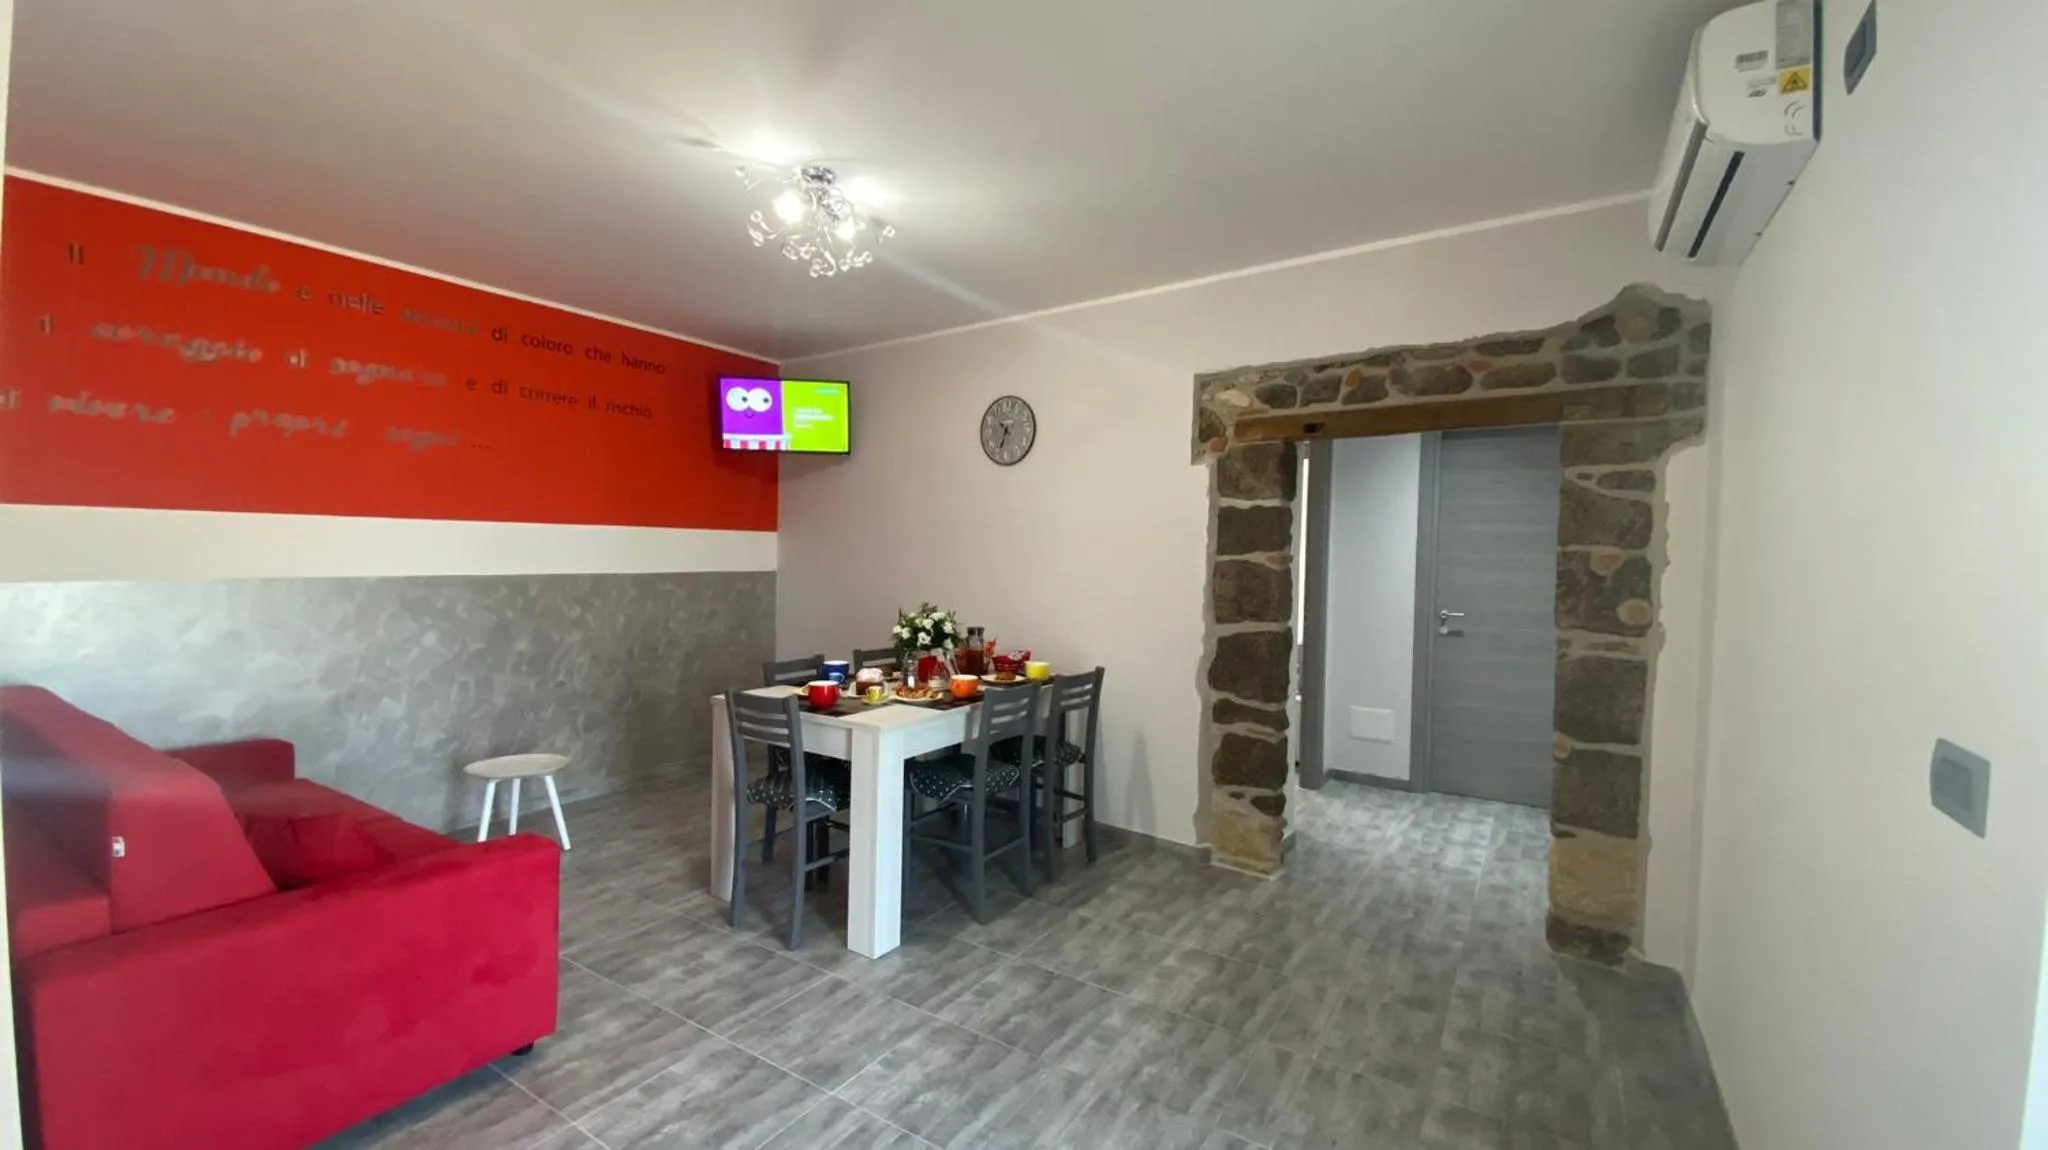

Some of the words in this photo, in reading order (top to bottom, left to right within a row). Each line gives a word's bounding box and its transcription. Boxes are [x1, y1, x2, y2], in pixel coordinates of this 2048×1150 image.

[68, 243, 84, 265] Il
[327, 292, 385, 315] nelle
[491, 326, 509, 343] di
[520, 332, 574, 355] coloro
[584, 345, 612, 363] che
[621, 353, 667, 375] hanno
[466, 378, 477, 391] e
[491, 379, 509, 395] di
[519, 386, 578, 405] correre
[588, 395, 596, 411] il
[606, 399, 653, 419] rischio
